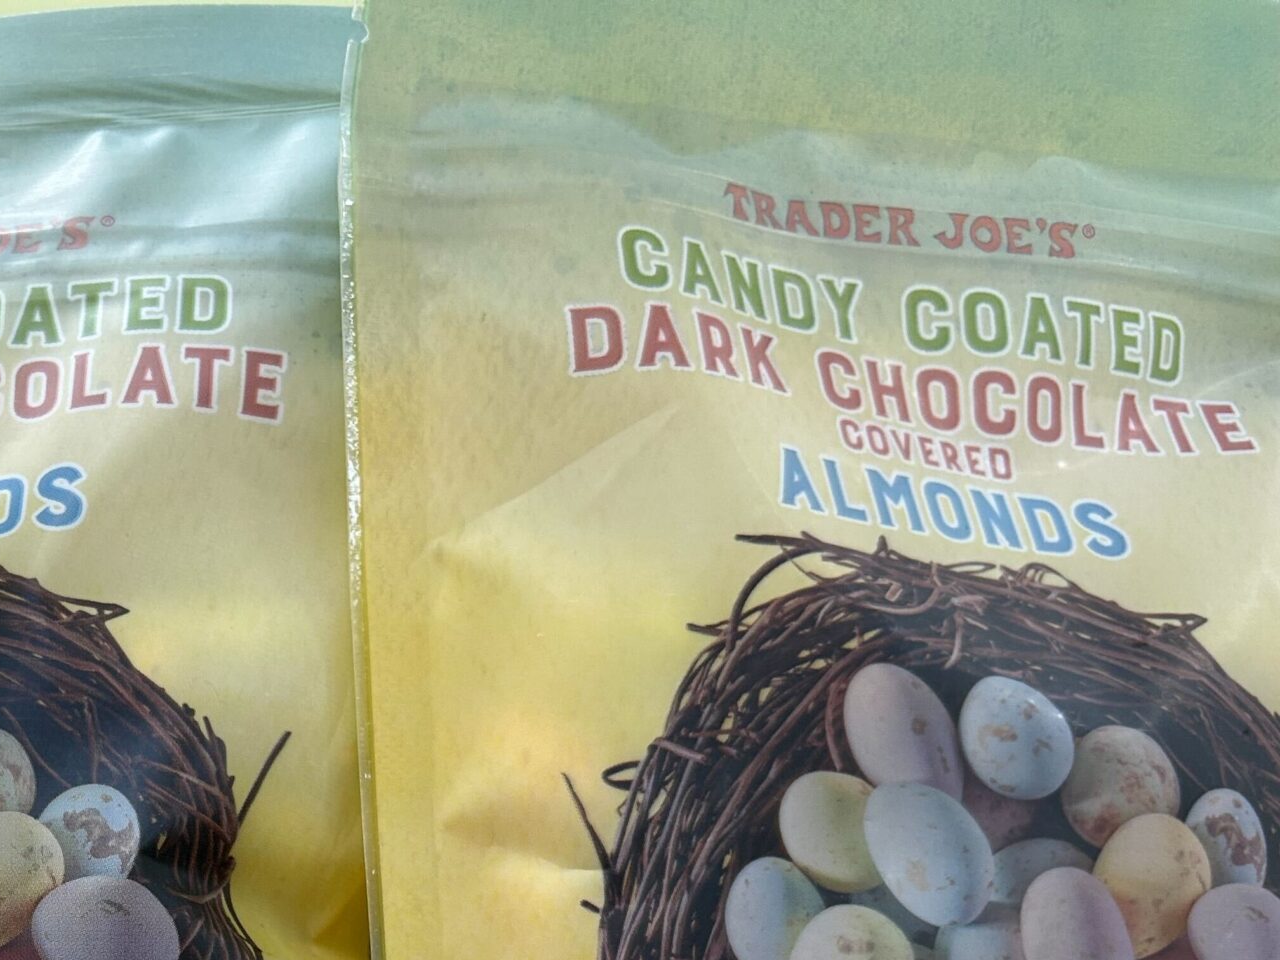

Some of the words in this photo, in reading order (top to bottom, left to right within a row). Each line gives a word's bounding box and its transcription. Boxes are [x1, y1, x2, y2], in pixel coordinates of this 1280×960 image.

[724, 182, 920, 247] TRADER
[620, 229, 862, 342] CANDY
[906, 287, 1184, 384] COATED
[569, 304, 787, 394] DARK
[819, 350, 1257, 455] CHOCOLATE
[780, 447, 1132, 560] ALMONDS
[838, 418, 1014, 481] COVERED
